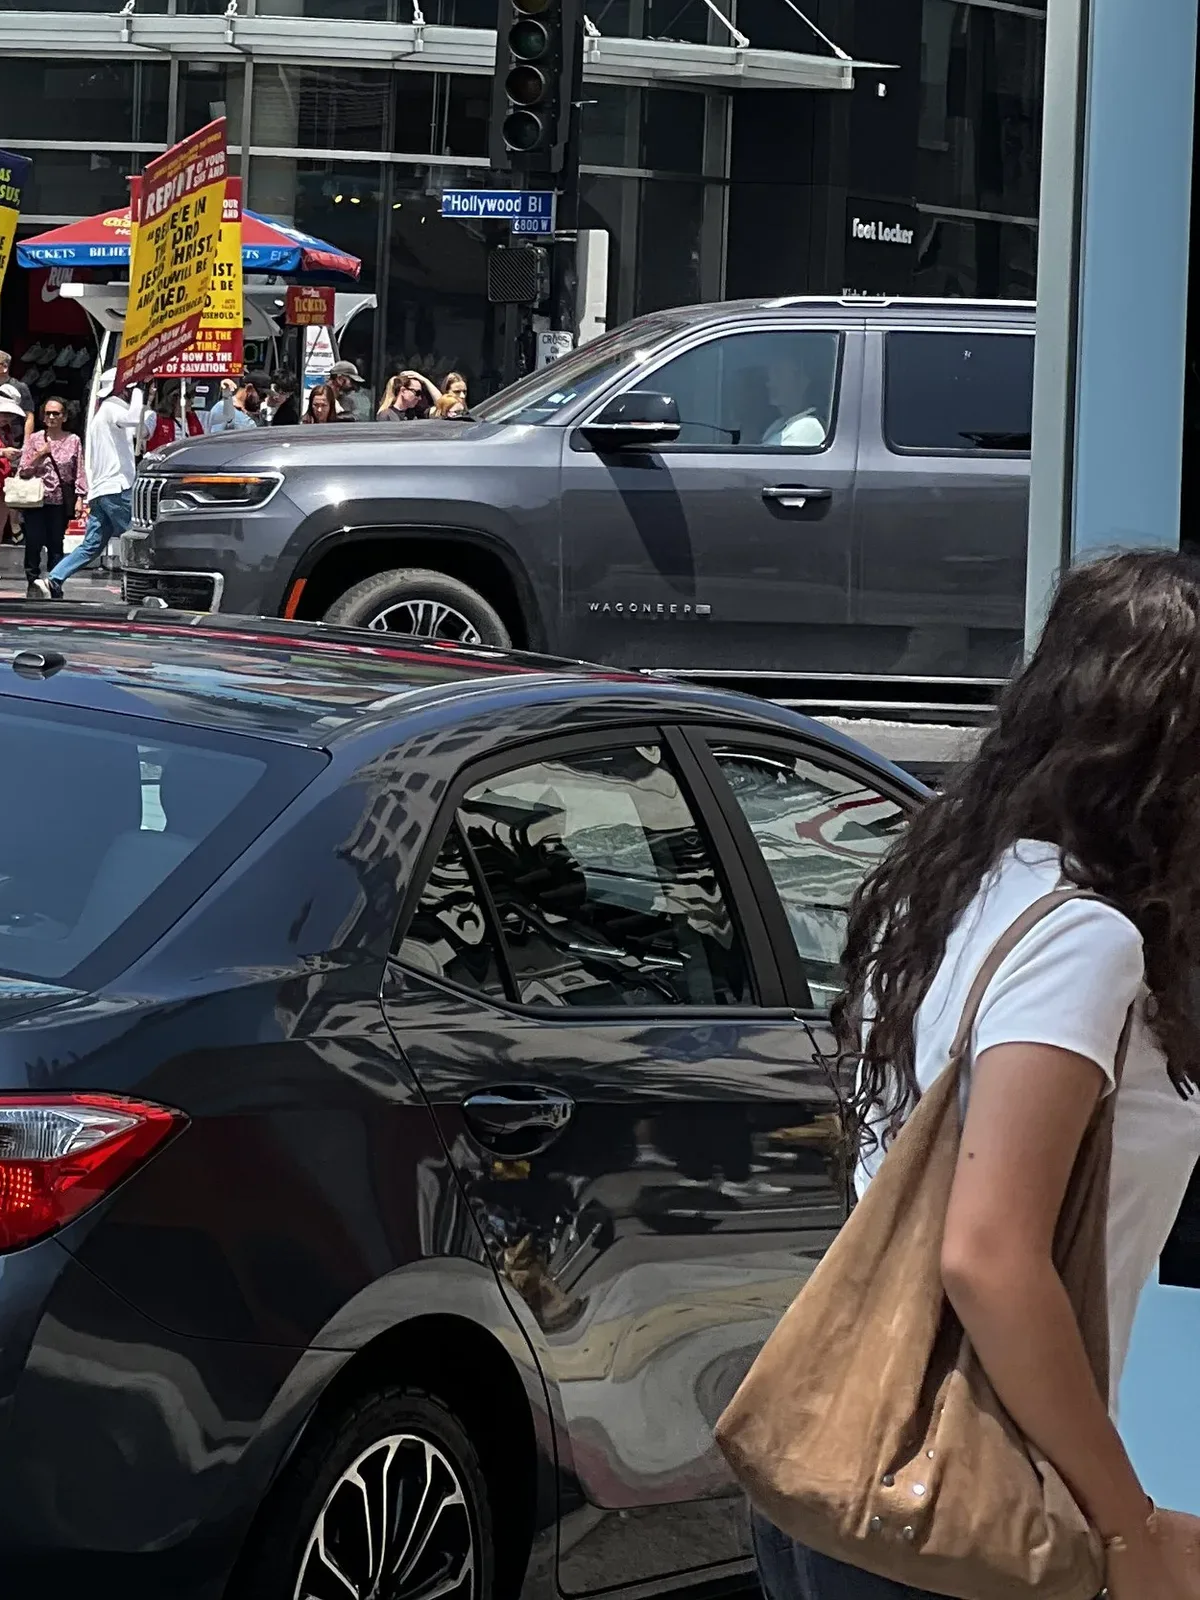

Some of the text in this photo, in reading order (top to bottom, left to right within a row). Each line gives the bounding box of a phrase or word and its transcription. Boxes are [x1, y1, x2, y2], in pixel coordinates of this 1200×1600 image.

[205, 150, 226, 167] YOUR
[208, 164, 225, 179] AND
[194, 195, 207, 218] IN
[451, 195, 542, 215] Hollywood Bl
[222, 209, 239, 219] AND
[514, 219, 549, 231] 6800 W
[852, 217, 914, 244] Foot Locker
[27, 248, 76, 259] TICKETS
[195, 257, 208, 274] BE
[220, 280, 234, 291] BE
[294, 297, 327, 313] TICKETS
[205, 331, 213, 340] IS
[215, 330, 232, 340] THE
[182, 352, 204, 362] NOW
[205, 352, 214, 362] IS
[215, 352, 232, 362] THE
[166, 363, 177, 373] OF
[180, 363, 229, 373] SALVATION.
[587, 602, 692, 614] WAGONEER
